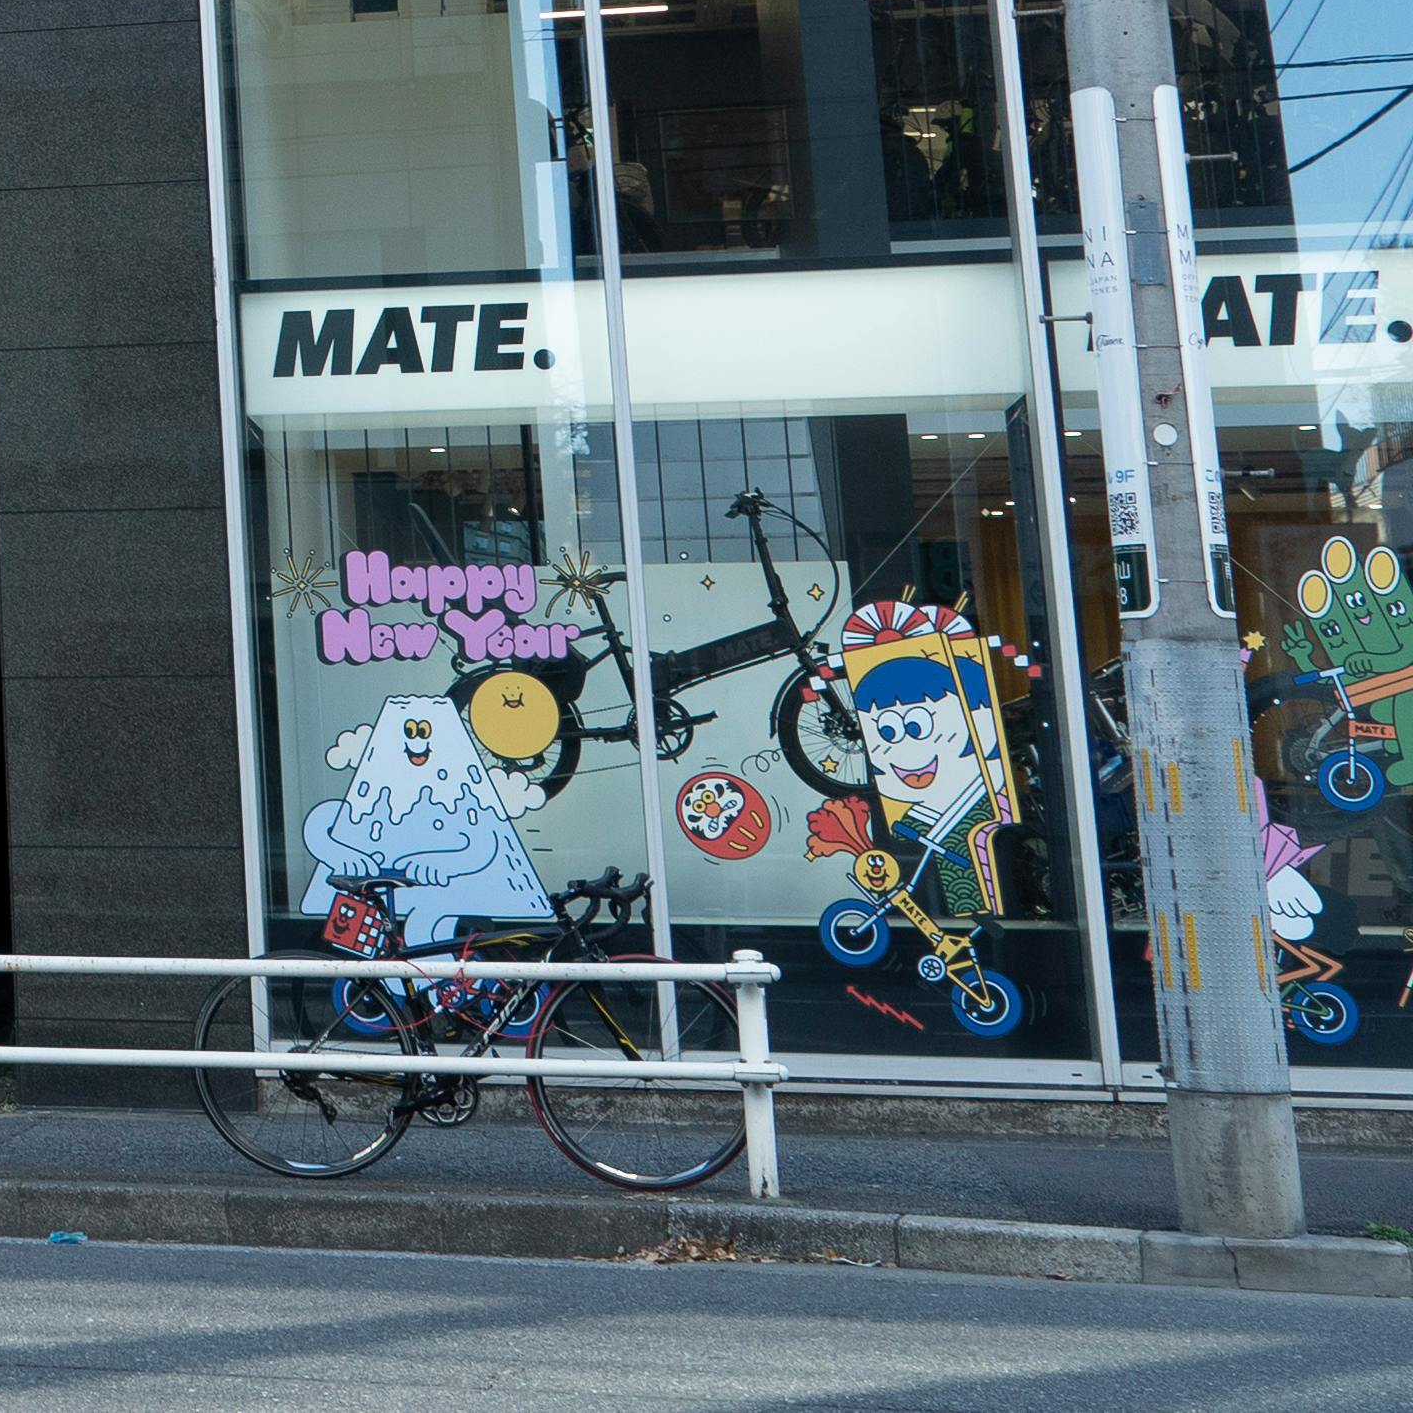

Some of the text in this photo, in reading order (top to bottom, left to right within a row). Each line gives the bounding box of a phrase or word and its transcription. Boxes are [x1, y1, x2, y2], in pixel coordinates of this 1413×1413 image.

[273, 302, 556, 377] MATE.
[1087, 270, 1413, 351] ATE.
[341, 550, 538, 616] Happy
[316, 608, 581, 665] New Year
[1355, 724, 1393, 737] MATE.
